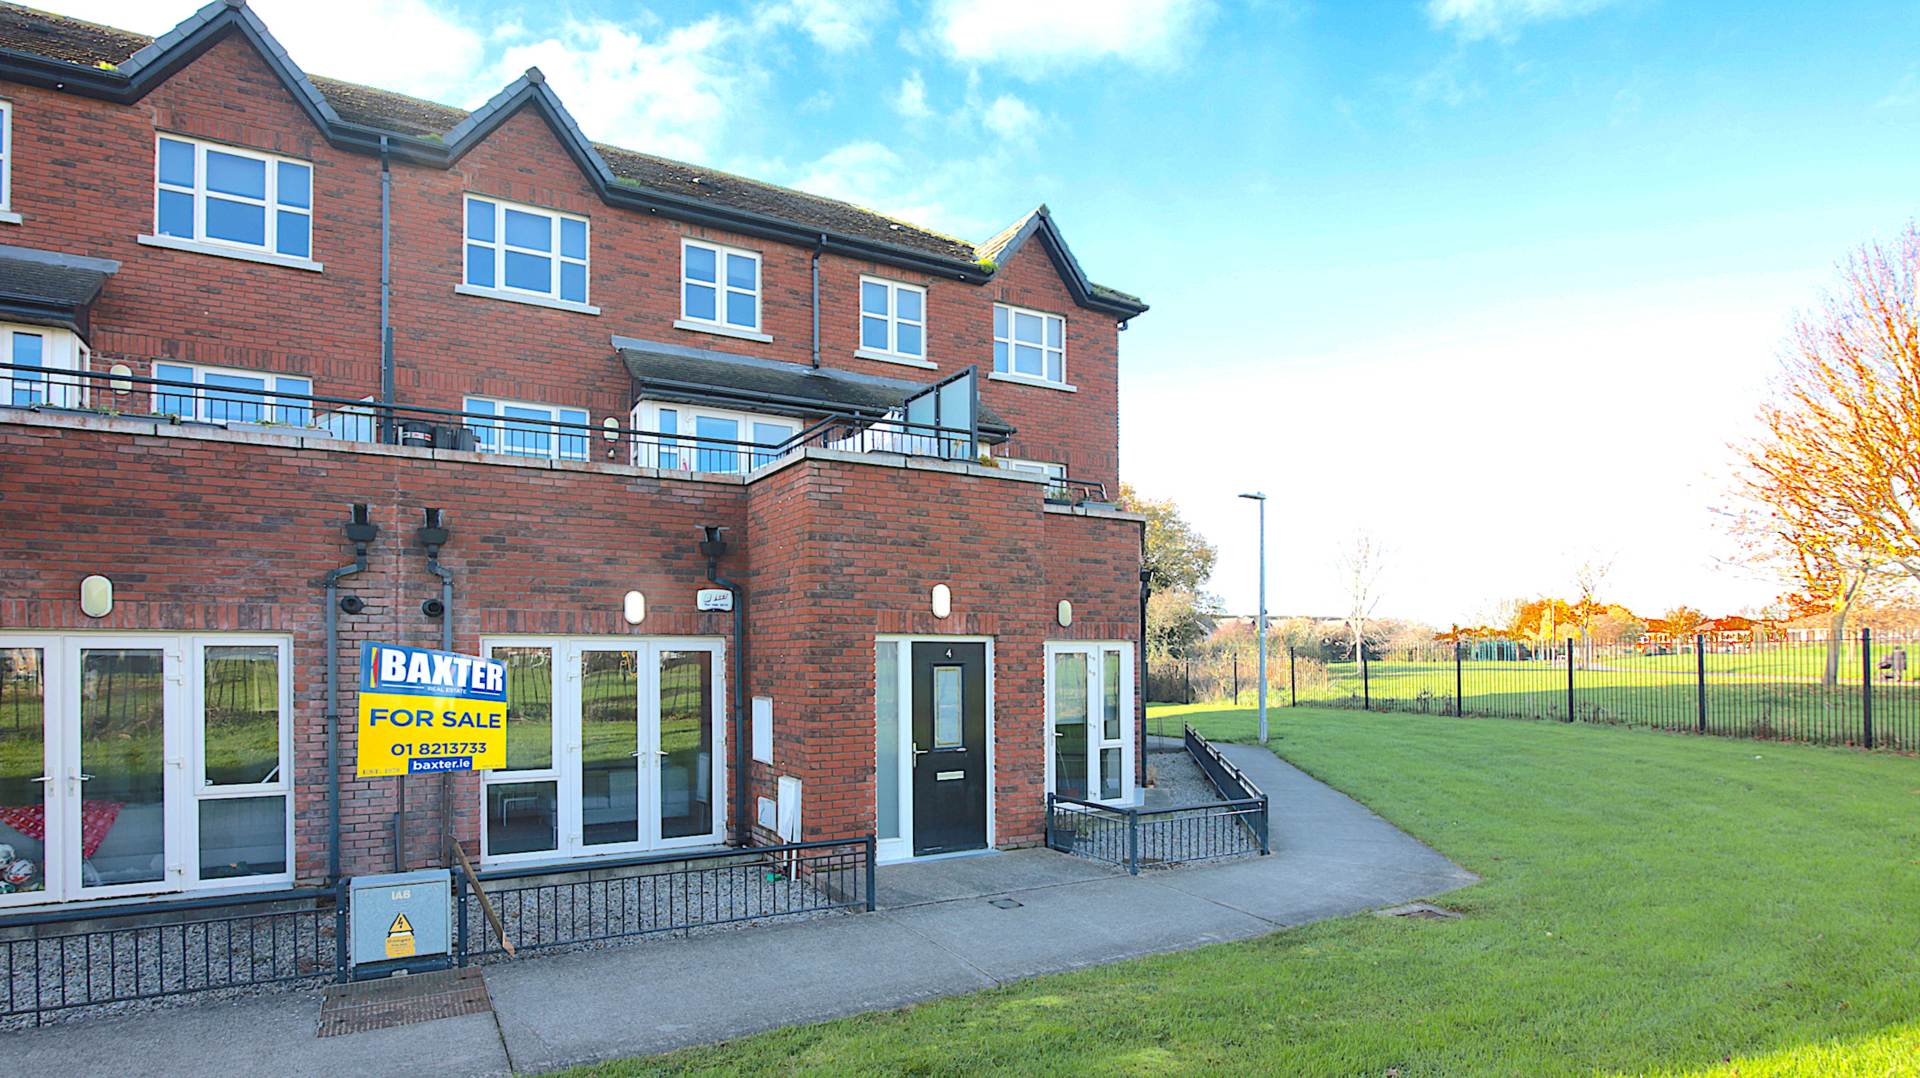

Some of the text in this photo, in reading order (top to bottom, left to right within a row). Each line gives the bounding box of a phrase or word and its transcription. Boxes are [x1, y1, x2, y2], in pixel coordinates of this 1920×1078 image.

[946, 648, 952, 658] 4
[381, 648, 503, 691] BAXTER
[370, 708, 501, 728] FOR SALE
[391, 743, 487, 755] 01 8213733
[413, 758, 470, 771] baxter.ie
